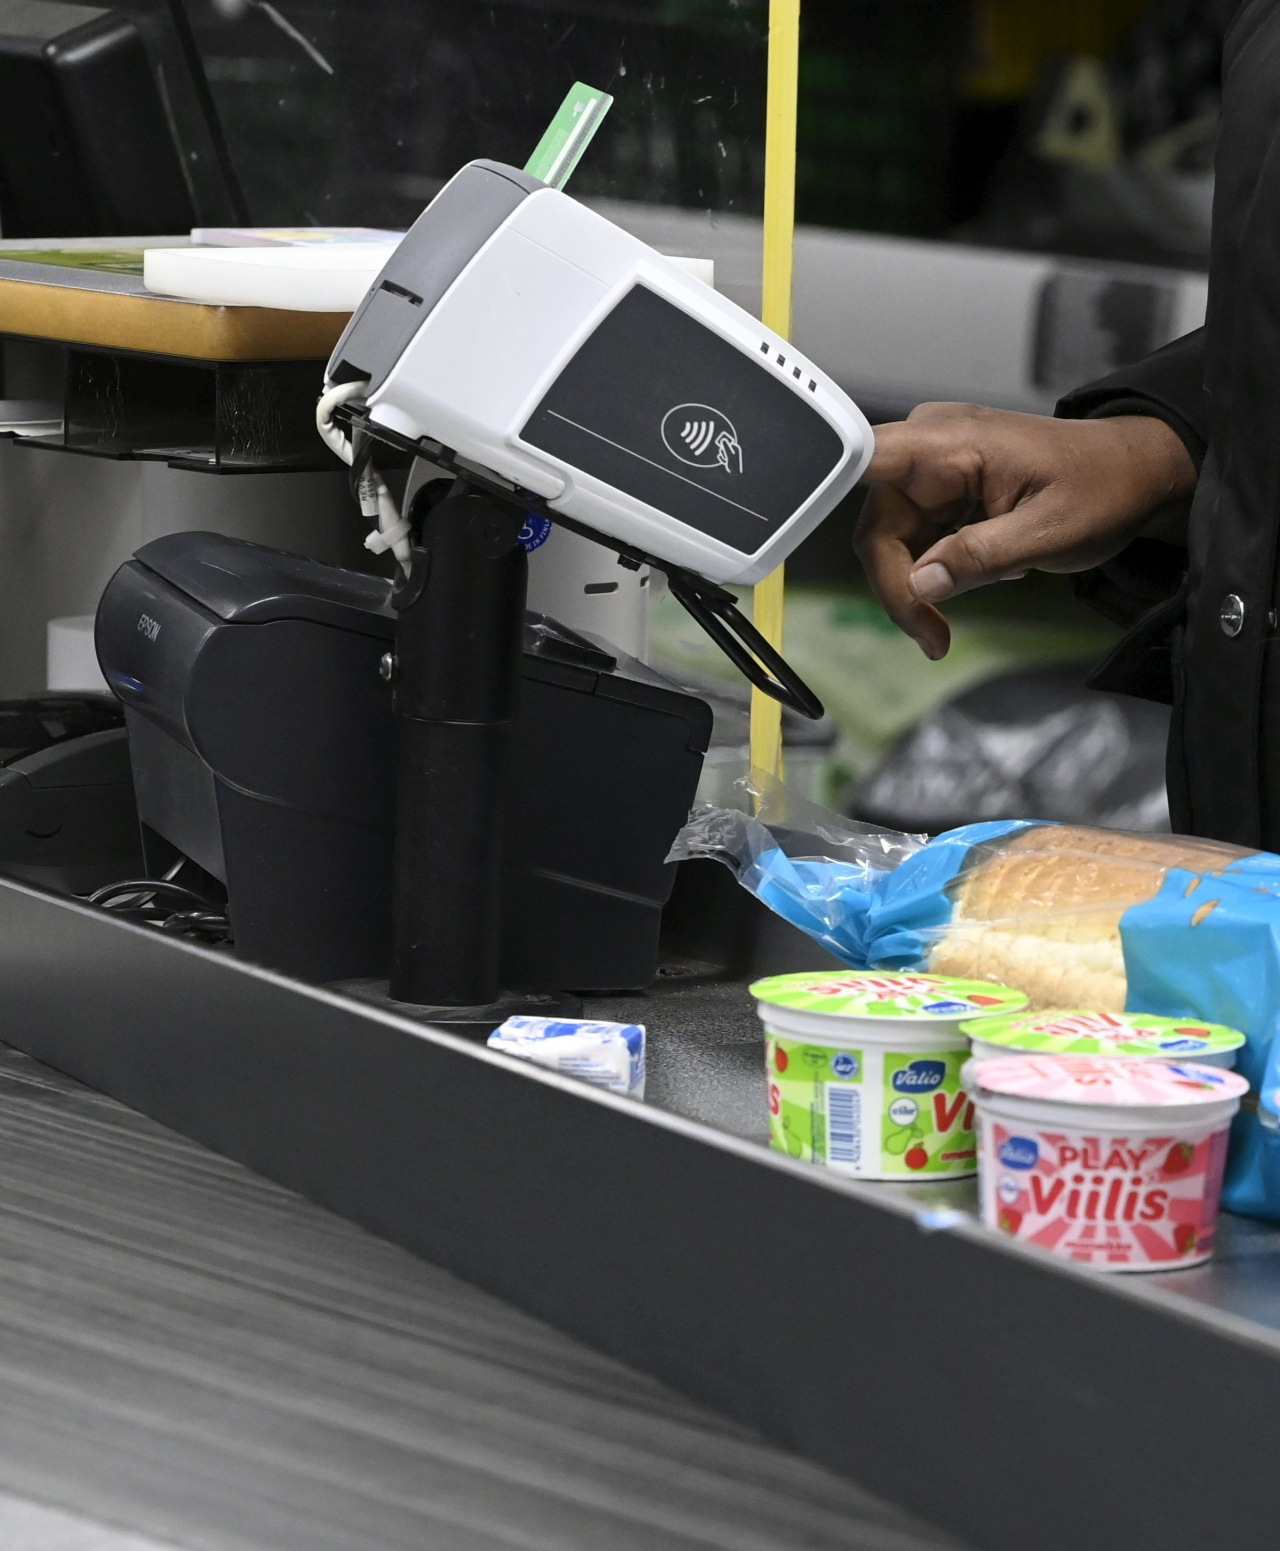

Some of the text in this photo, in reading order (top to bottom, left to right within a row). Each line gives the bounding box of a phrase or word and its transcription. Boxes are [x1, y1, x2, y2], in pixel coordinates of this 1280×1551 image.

[137, 613, 162, 642] EPSON
[895, 1068, 941, 1085] Valio
[1059, 1146, 1148, 1171] PLAY
[1030, 1174, 1169, 1222] Viilis
